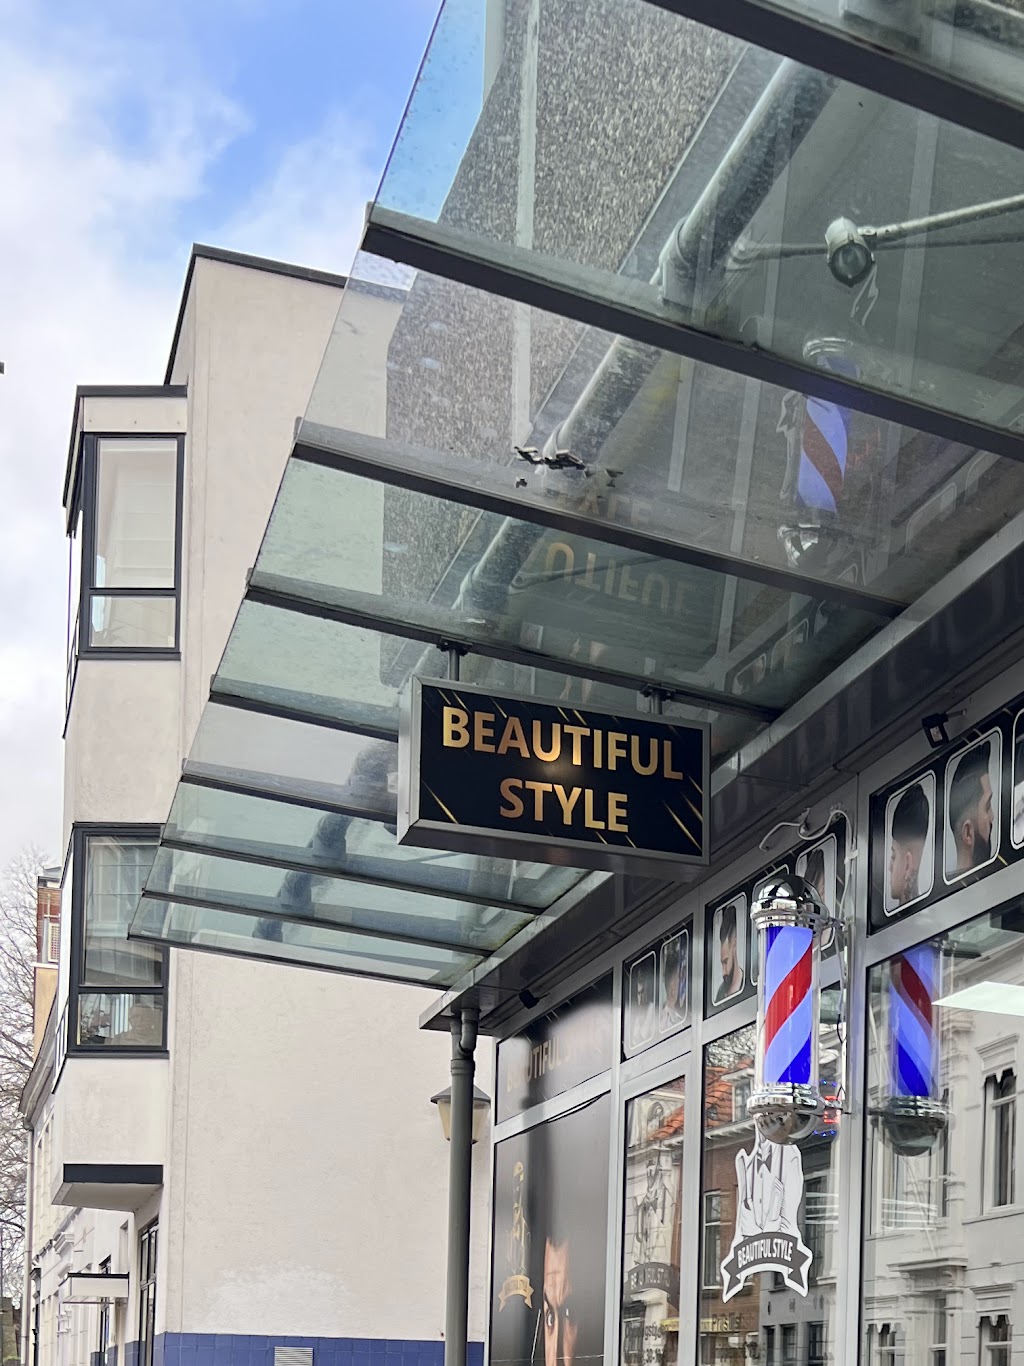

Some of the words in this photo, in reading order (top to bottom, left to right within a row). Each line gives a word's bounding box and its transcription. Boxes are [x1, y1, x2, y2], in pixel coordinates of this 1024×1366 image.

[442, 705, 683, 781] BEAUTIFUL
[499, 777, 629, 833] STYLE
[738, 1238, 772, 1269] BEAUTIFUL
[772, 1237, 793, 1262] STYLE
